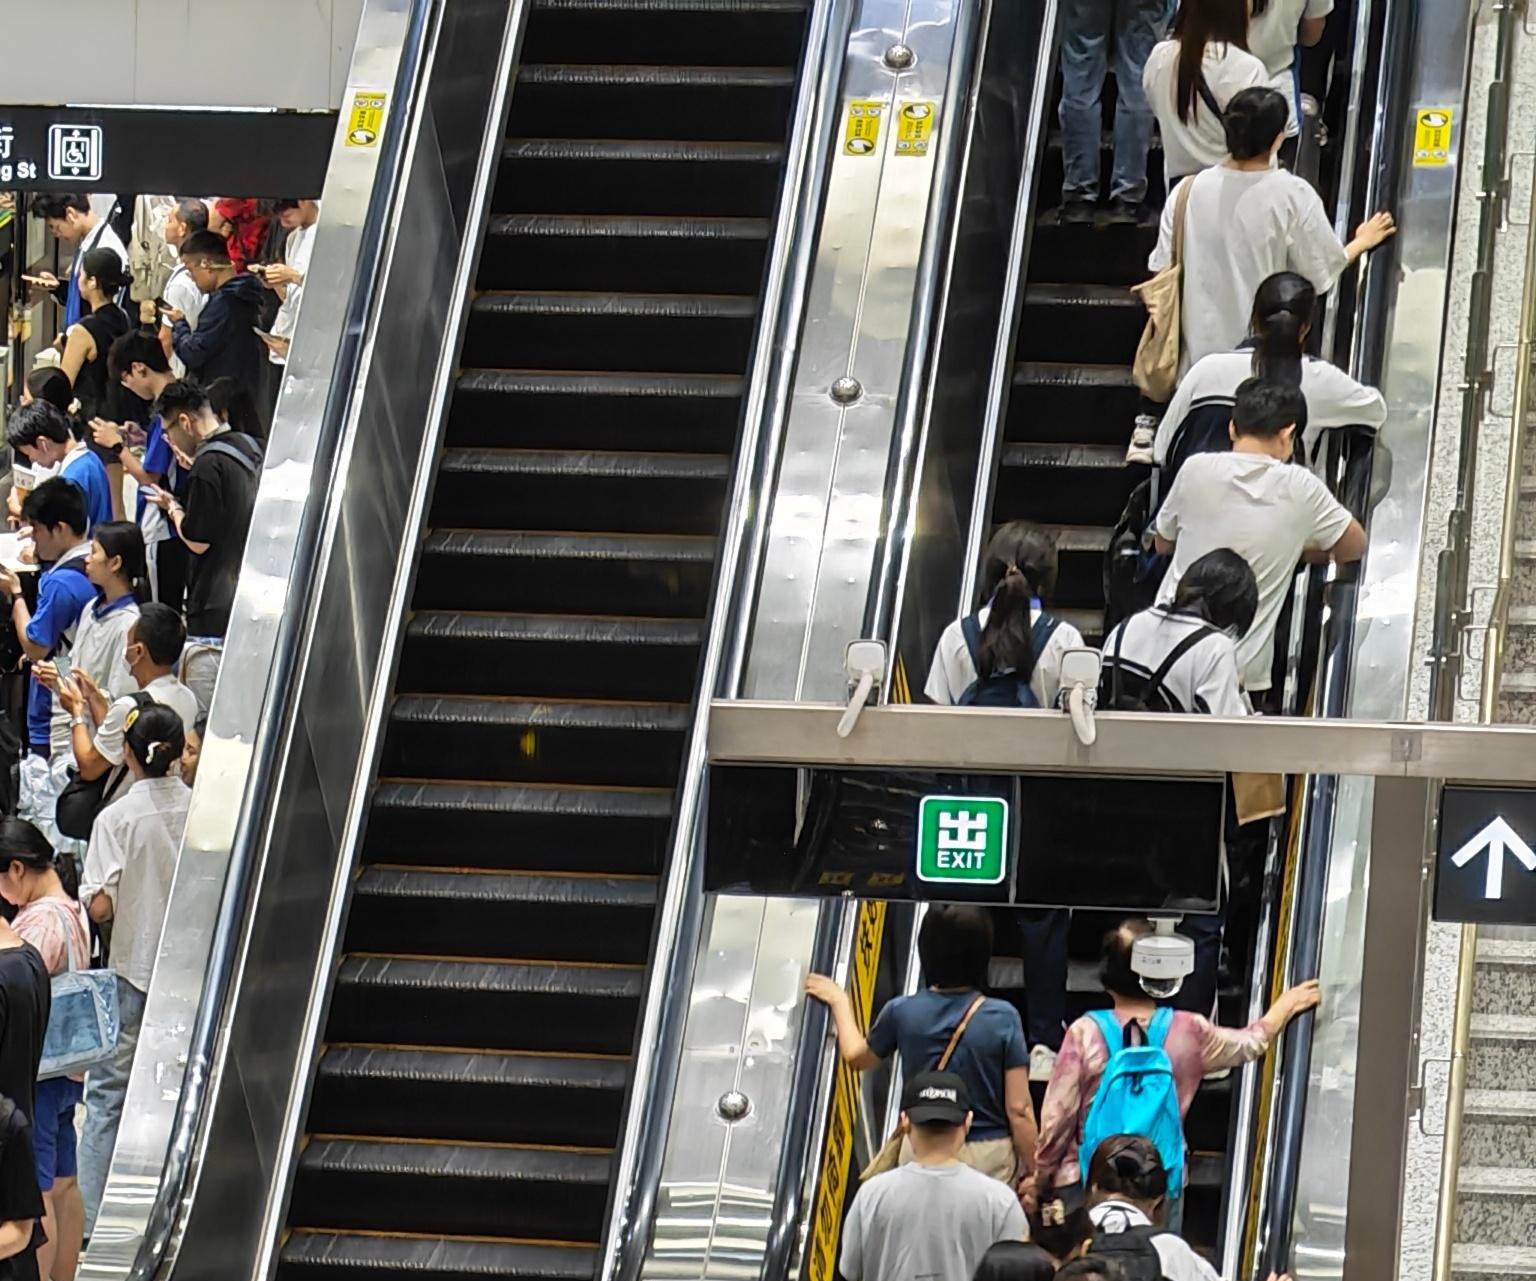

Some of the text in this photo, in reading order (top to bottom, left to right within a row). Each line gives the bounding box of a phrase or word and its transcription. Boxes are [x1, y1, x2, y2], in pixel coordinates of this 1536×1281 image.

[16, 162, 37, 180] St
[938, 811, 988, 850] 出
[937, 851, 986, 869] EXIT
